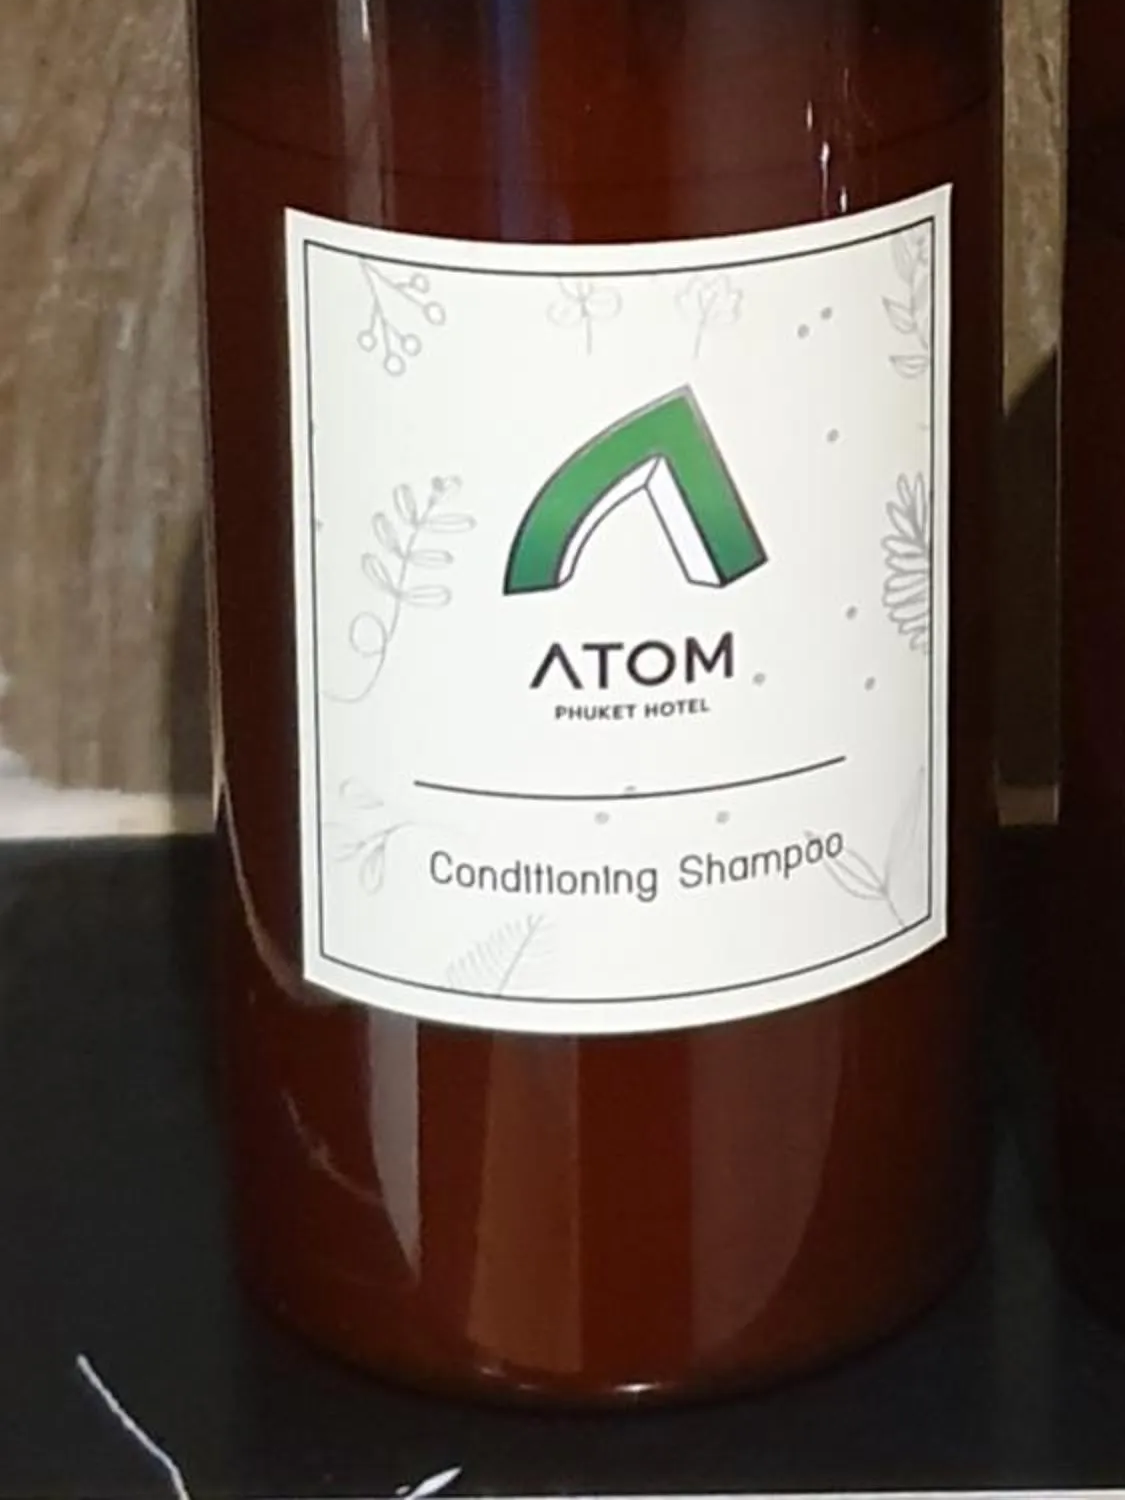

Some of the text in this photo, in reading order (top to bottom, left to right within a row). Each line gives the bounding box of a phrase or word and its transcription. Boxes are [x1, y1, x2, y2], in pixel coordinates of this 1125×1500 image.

[529, 631, 733, 689] ATOM
[554, 698, 710, 720] PHUKET HOTEL
[430, 832, 844, 902] Conditioning Shampoo
